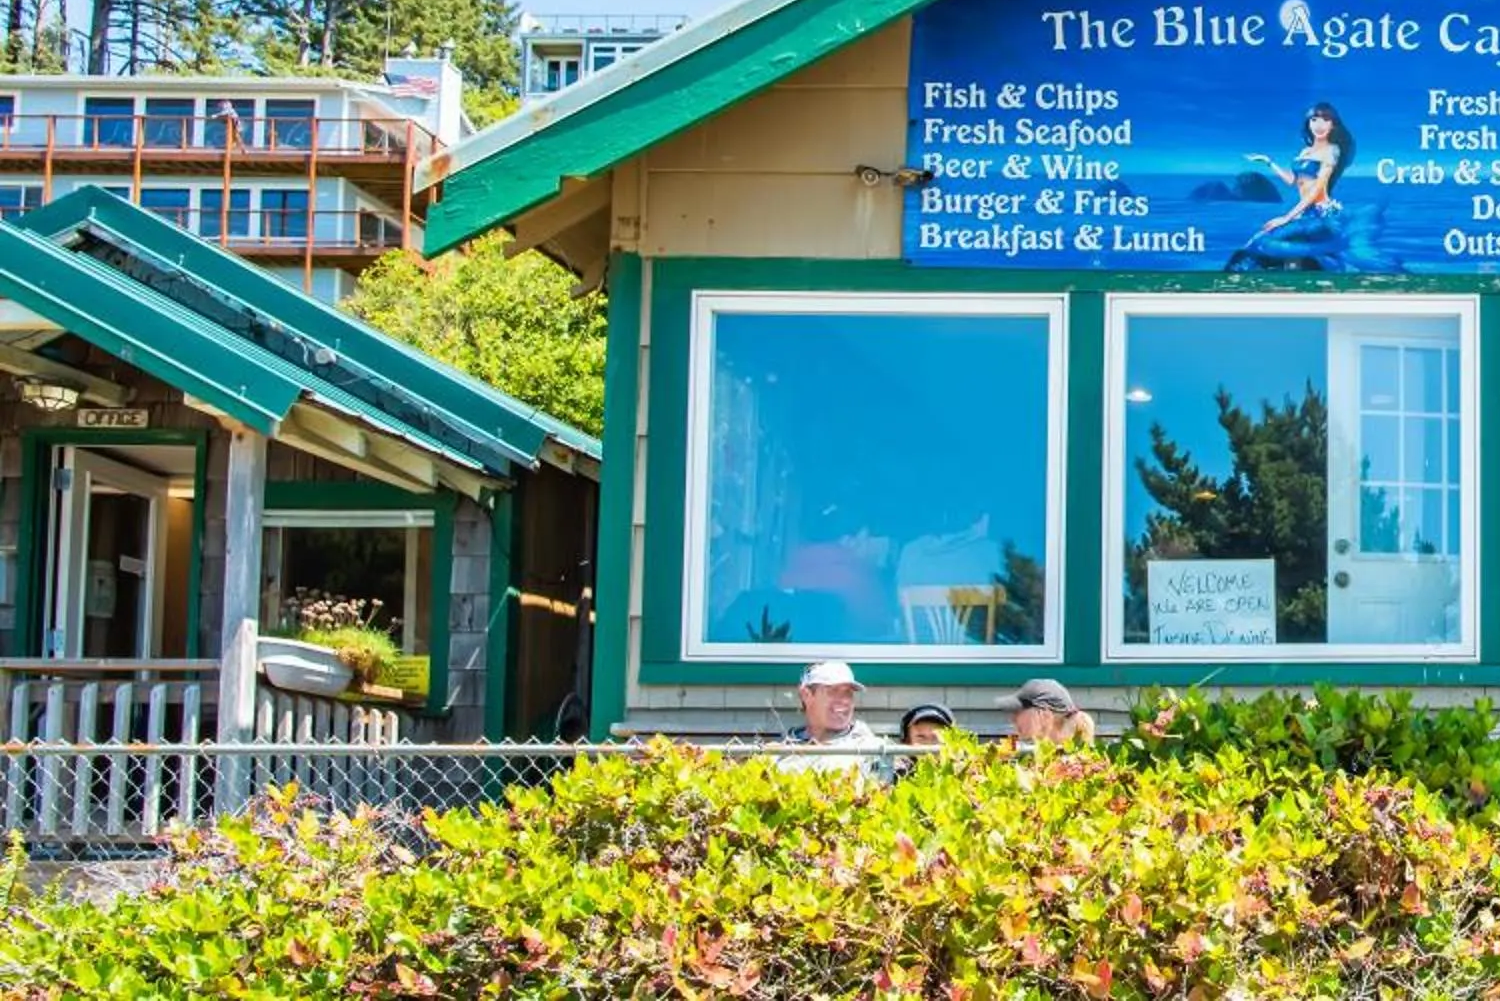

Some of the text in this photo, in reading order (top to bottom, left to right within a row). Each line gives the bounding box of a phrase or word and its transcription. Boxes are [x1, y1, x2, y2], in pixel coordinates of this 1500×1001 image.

[1042, 10, 1136, 50] The
[1153, 6, 1265, 46] Blue
[1282, 5, 1421, 58] Agate
[923, 82, 1119, 115] Fish & Chips
[923, 118, 1131, 151] Fresh Seafood
[1420, 125, 1497, 150] Fresh
[923, 153, 1119, 180] Beer & Wine
[1376, 158, 1444, 184] Crab
[1454, 159, 1482, 185] &
[921, 189, 1149, 220] Burger & Fries
[919, 223, 1205, 255] Breakfast & Lunch
[85, 410, 145, 426] OFFICE
